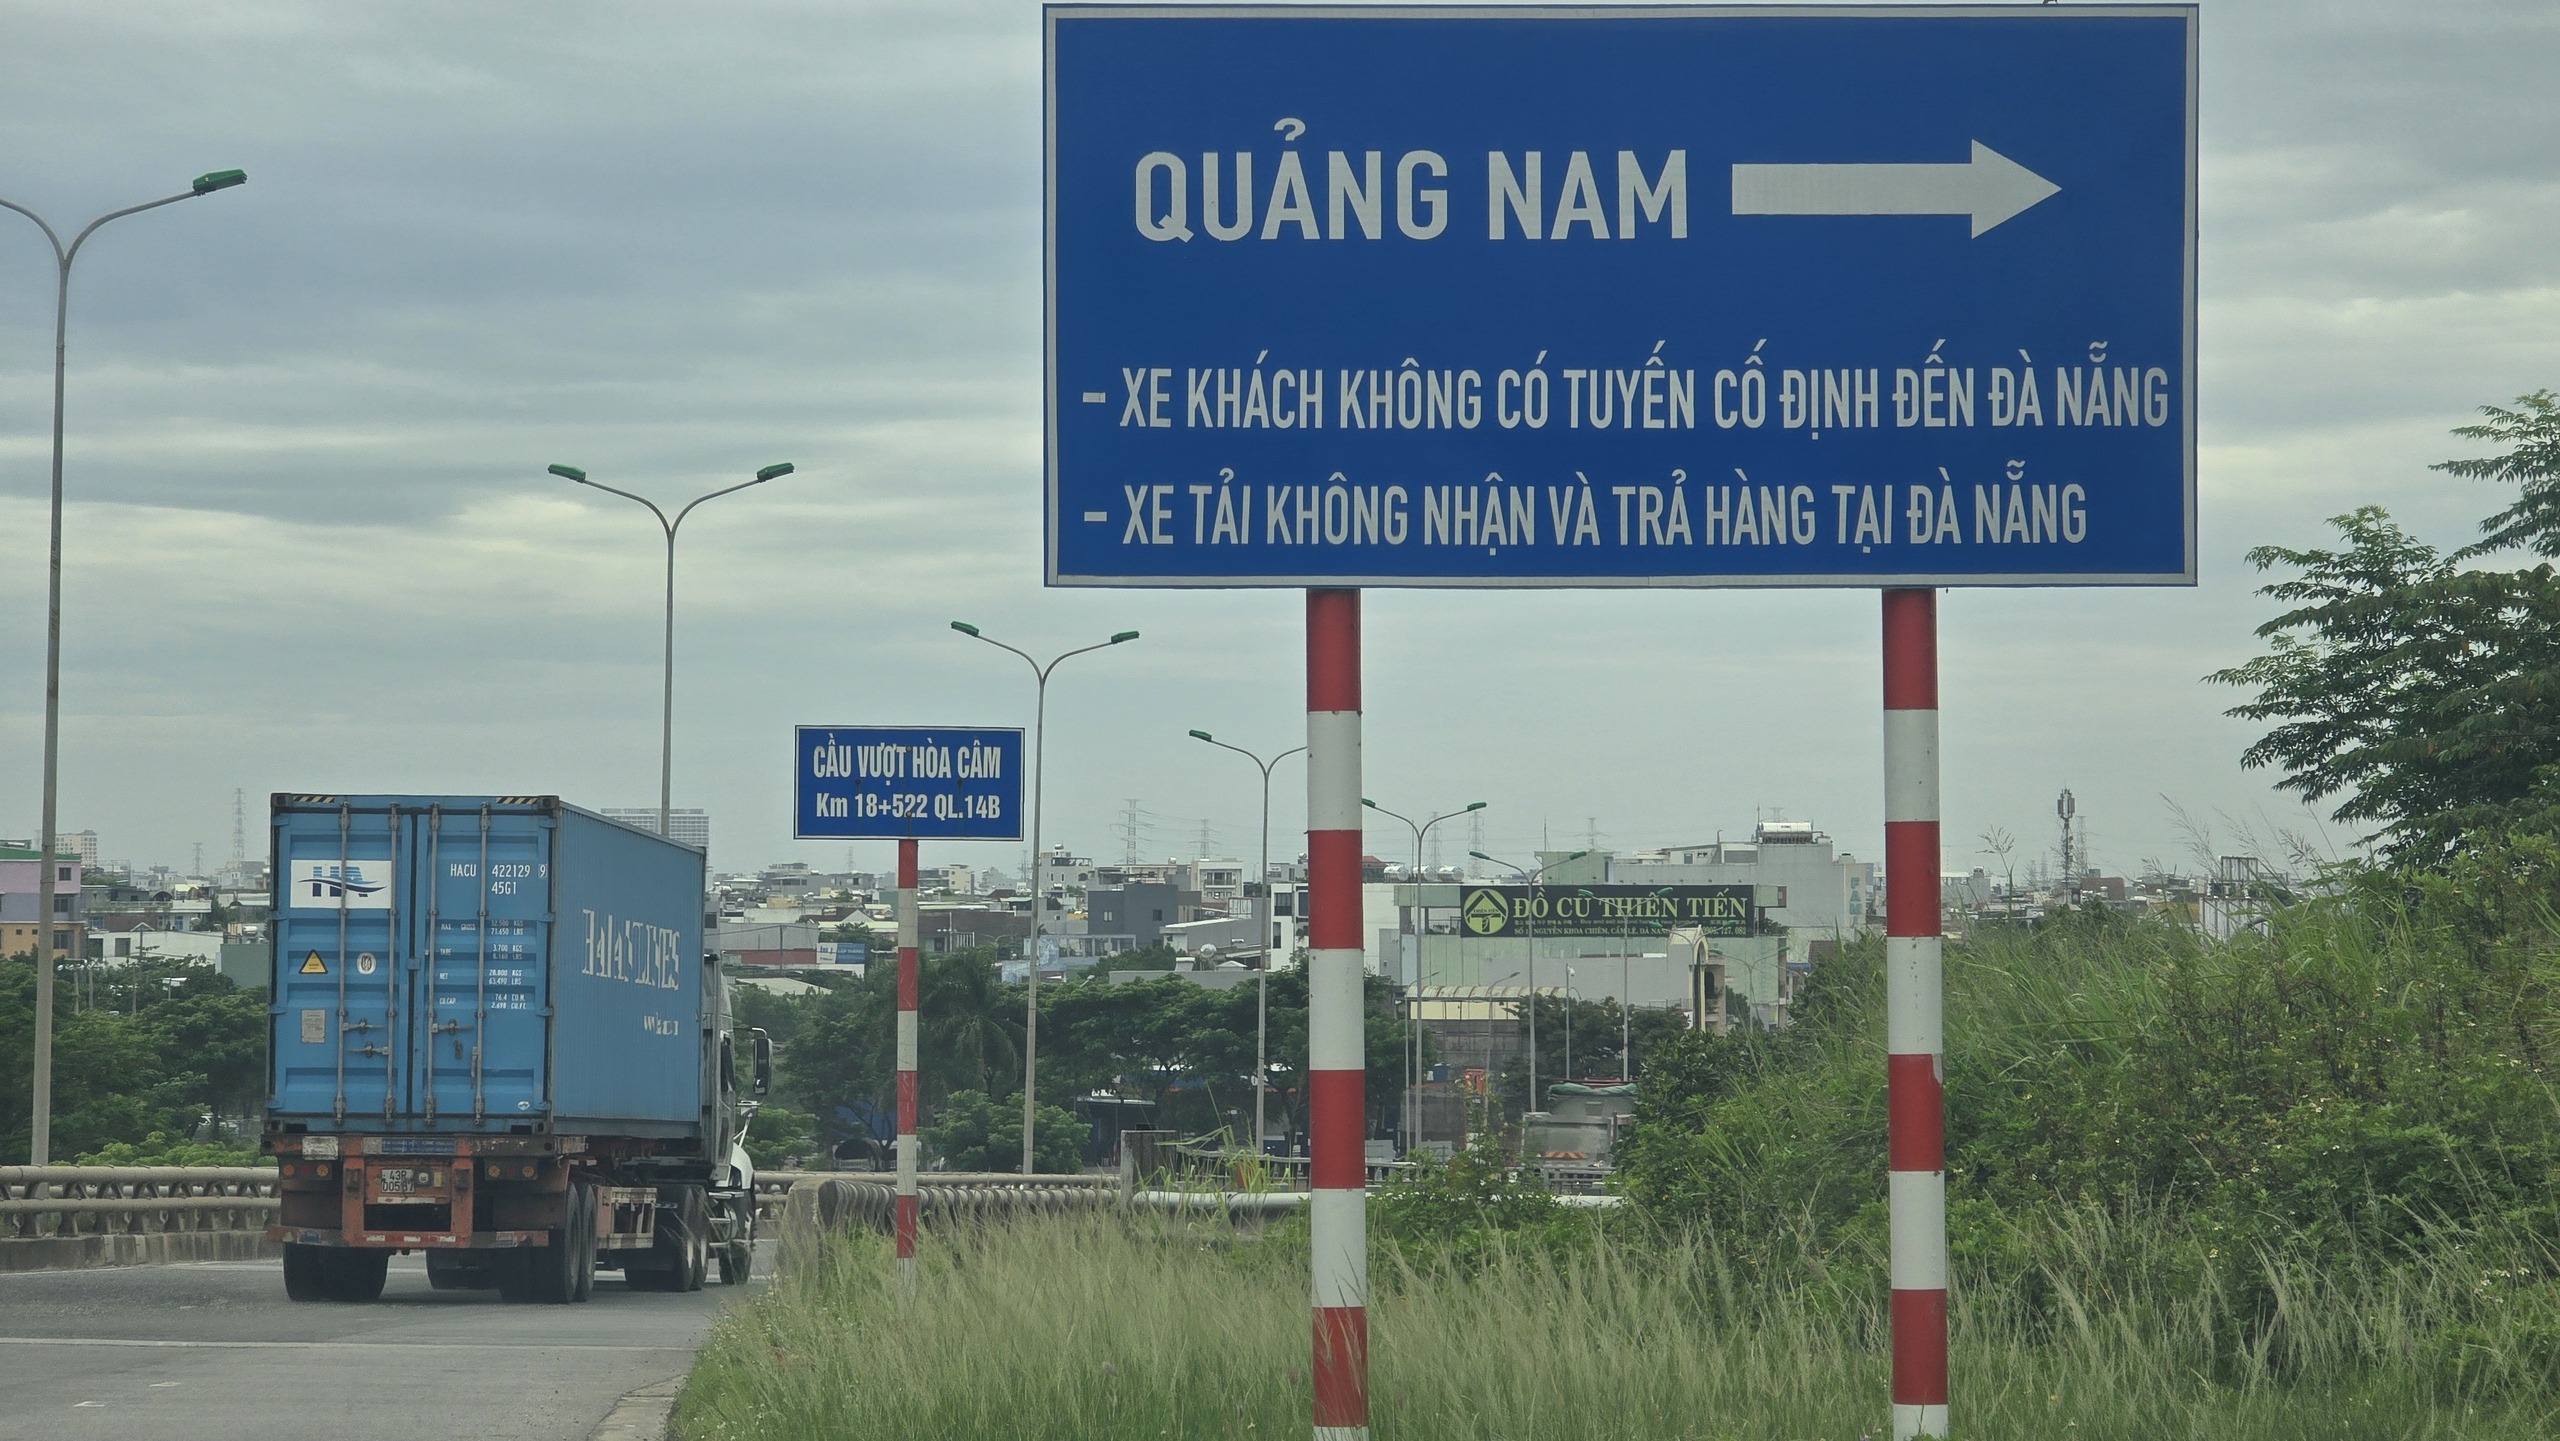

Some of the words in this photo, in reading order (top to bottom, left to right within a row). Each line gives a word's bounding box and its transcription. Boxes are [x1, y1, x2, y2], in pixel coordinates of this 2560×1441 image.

[1134, 116, 1449, 244] QUẢNG
[1487, 148, 1689, 241] NAM
[1118, 366, 1172, 429] XE
[1186, 349, 1323, 430] KHÁCH
[1340, 357, 1482, 430] KHÔNG
[1497, 350, 1549, 430] CÓ
[1563, 340, 1695, 430] TUYẾN
[1714, 338, 1767, 430] CỐ
[1778, 367, 1879, 440] ĐỊNH
[1892, 338, 1974, 428] ĐẾN
[1987, 349, 2044, 428] ĐÀ
[2057, 341, 2168, 428] NẴNG
[1122, 485, 1174, 545] XE
[1189, 467, 1251, 545] TẢI
[1266, 471, 1408, 545] KHÔNG
[1424, 472, 1535, 556] NHẬN
[1548, 471, 1601, 546] VÀ
[1612, 468, 1693, 546] TRẢ
[1706, 468, 1816, 545] HÀNG
[1831, 484, 1893, 554] TẠI
[1906, 466, 1962, 545] ĐÀ
[1975, 460, 2087, 545] NẴNG
[813, 732, 852, 778] CẦU
[857, 742, 907, 786] VƯỢT
[912, 737, 951, 778] HÒA
[816, 792, 848, 818] Km
[854, 793, 928, 818] 18+522
[934, 794, 1001, 821] QL.14B
[449, 863, 477, 877] HACU
[491, 864, 531, 878] 422129
[539, 864, 547, 878] 9
[491, 881, 517, 895] 45G1
[1513, 887, 1549, 918] ĐỒ
[1598, 891, 1680, 918] THIÊN
[1686, 888, 1748, 918] TIẾN
[389, 1170, 407, 1181] 43R
